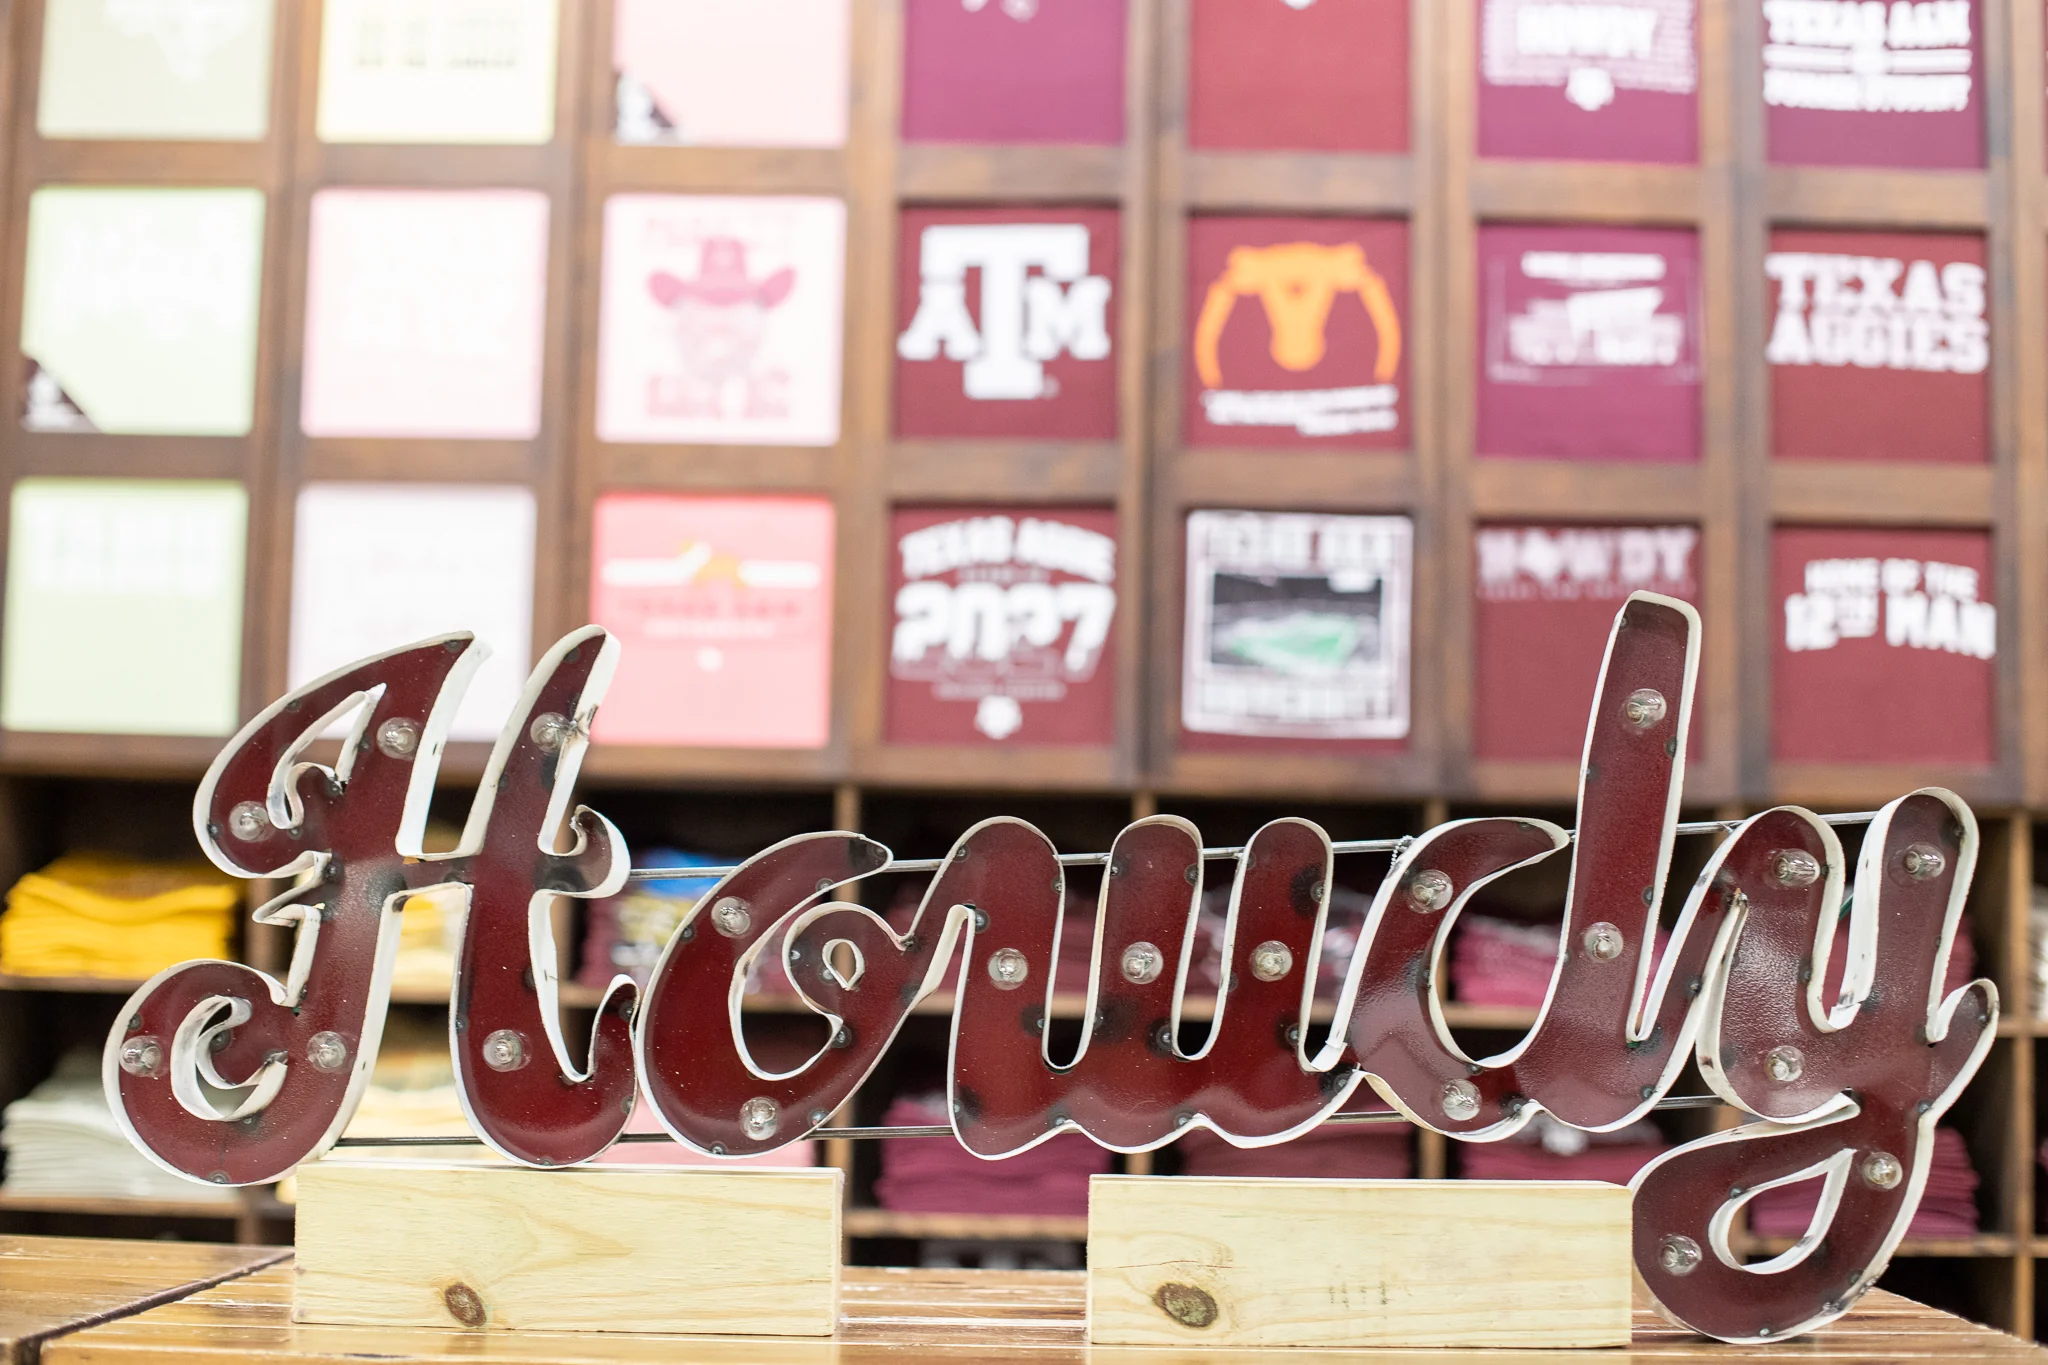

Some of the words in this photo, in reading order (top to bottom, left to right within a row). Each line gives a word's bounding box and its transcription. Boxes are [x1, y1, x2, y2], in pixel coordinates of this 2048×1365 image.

[1765, 252, 1985, 316] TEXAS
[1766, 308, 1989, 374] AGGIES
[1886, 590, 1997, 660] MAN
[103, 590, 2000, 1344] Howdy
